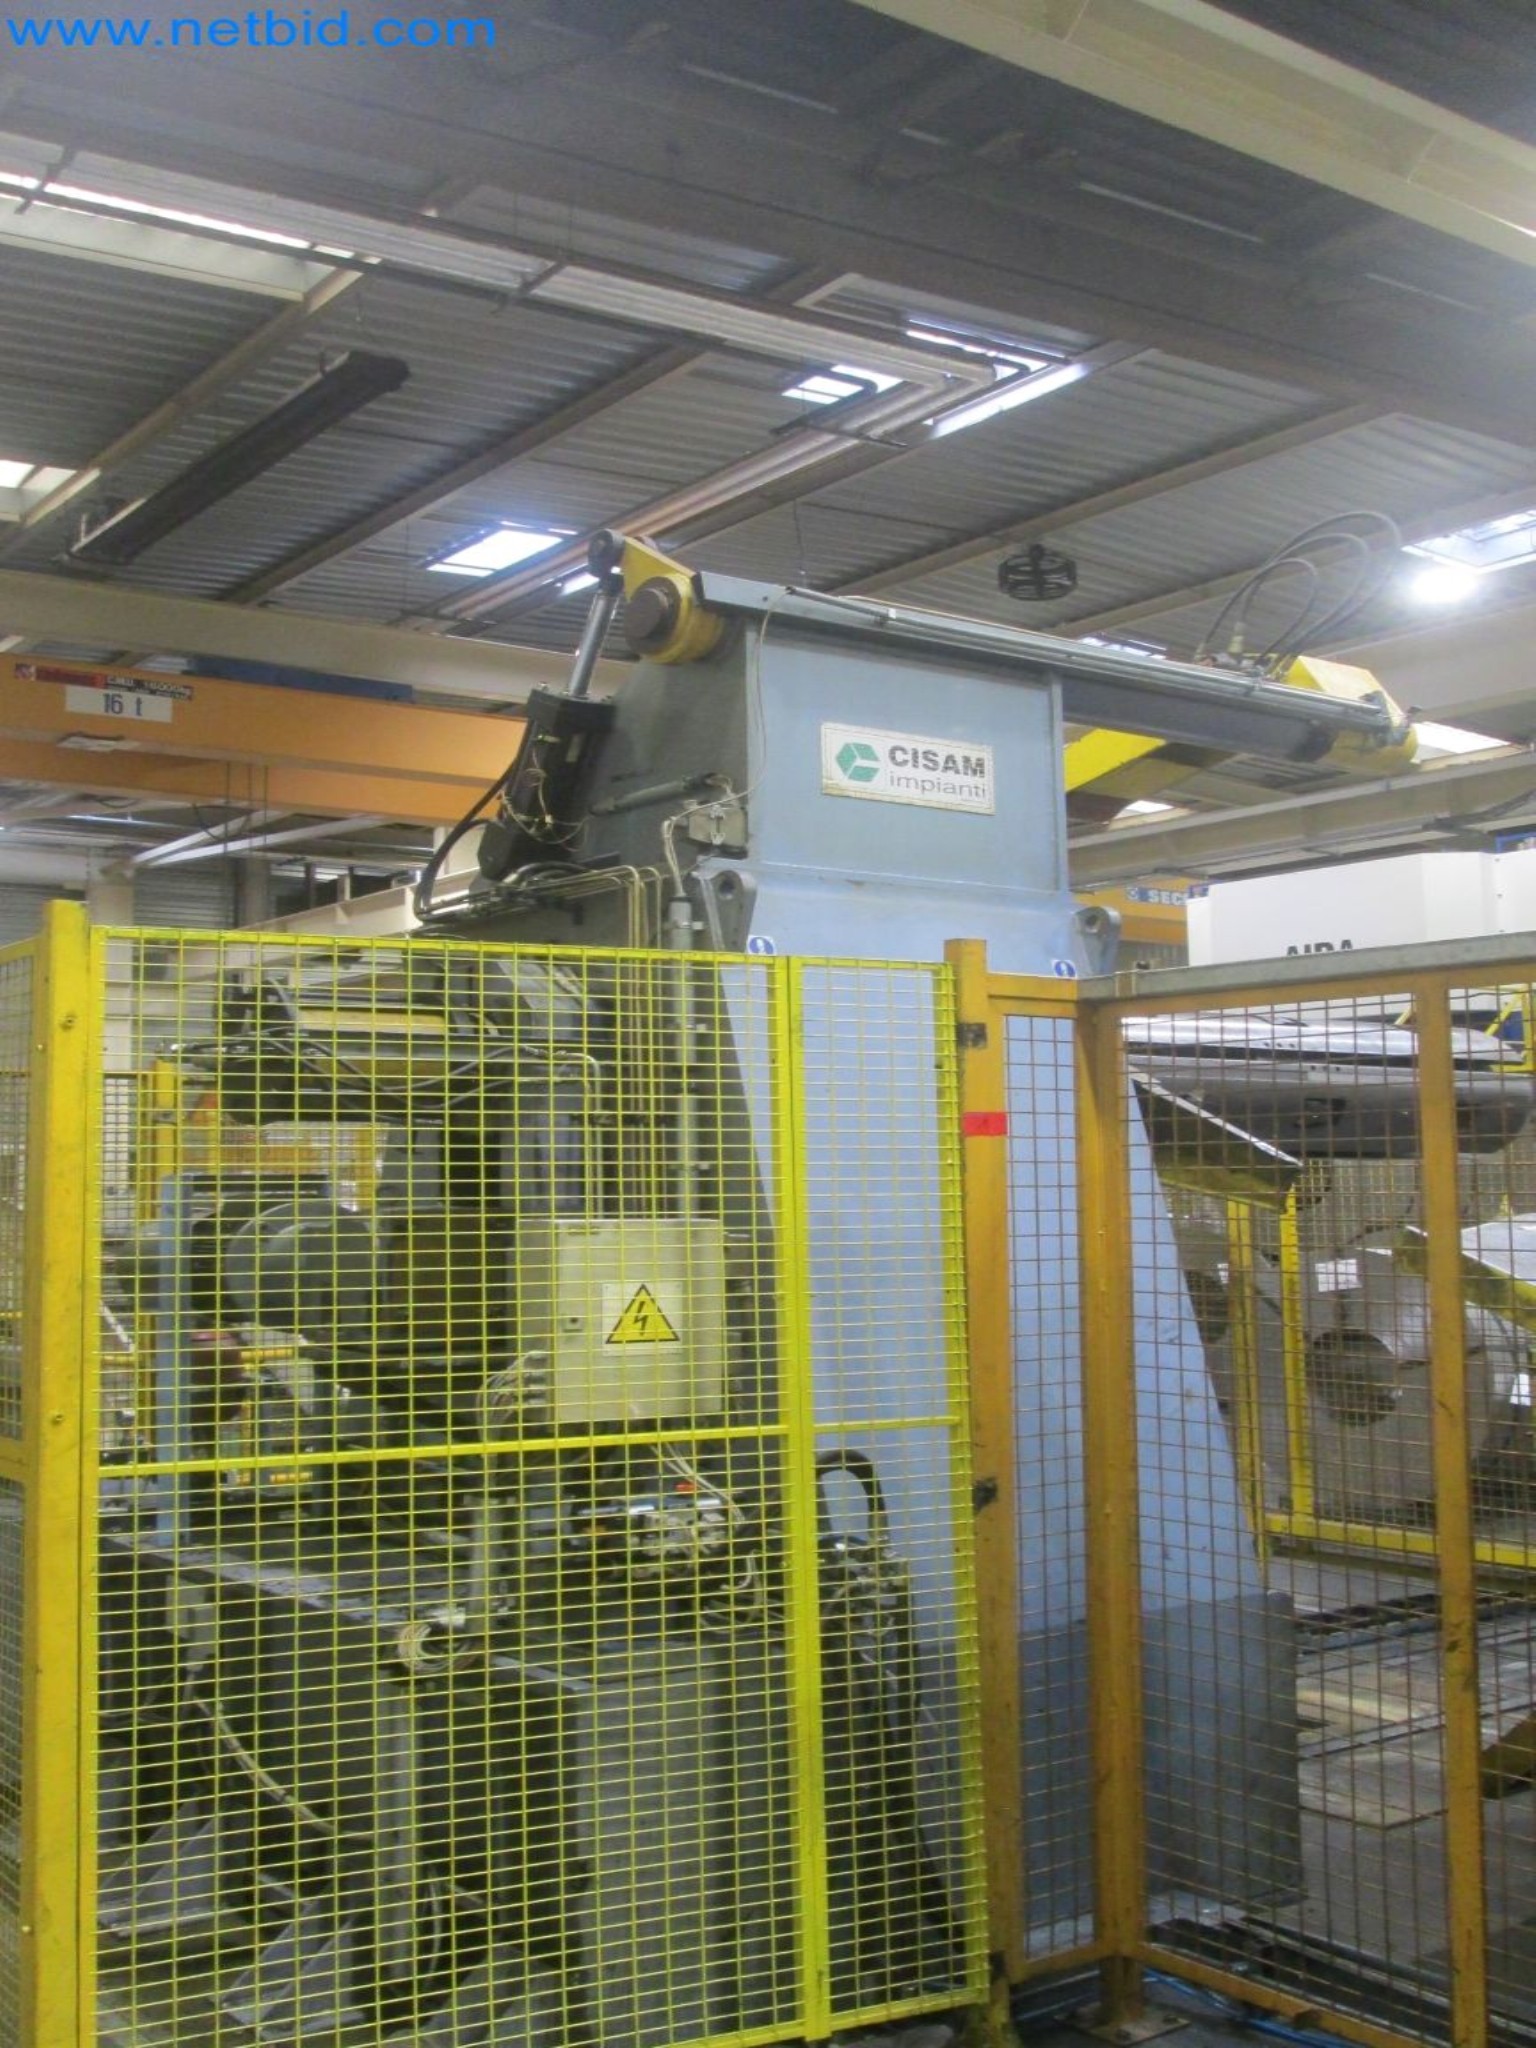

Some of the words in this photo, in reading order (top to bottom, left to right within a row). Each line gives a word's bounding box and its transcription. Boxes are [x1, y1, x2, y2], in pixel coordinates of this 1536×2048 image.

[103, 692, 124, 715] 16
[136, 697, 143, 716] t
[888, 745, 985, 778] CISAM
[889, 771, 986, 798] impianti
